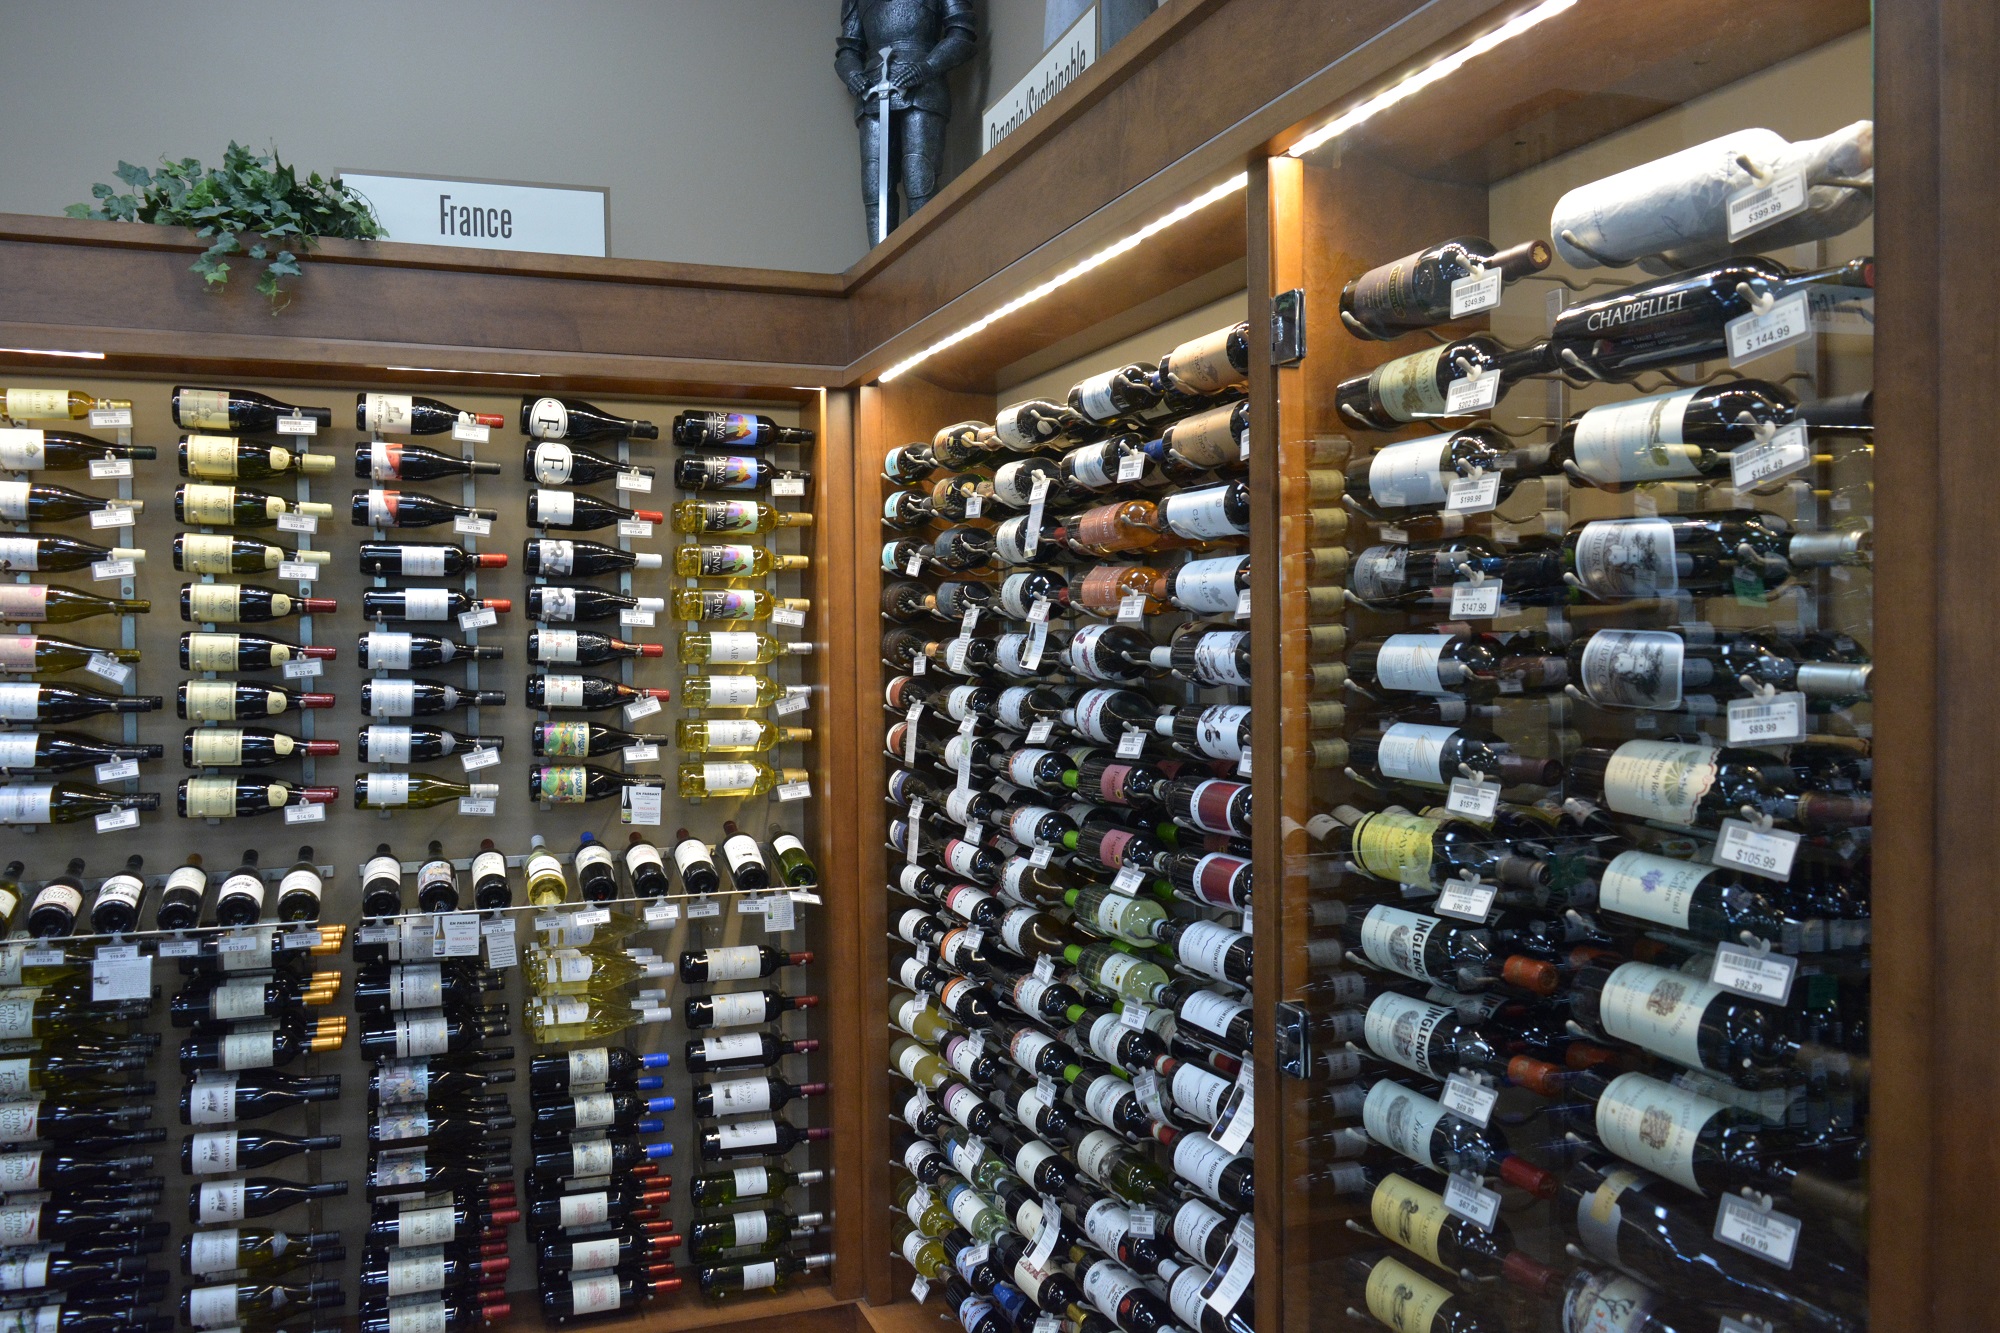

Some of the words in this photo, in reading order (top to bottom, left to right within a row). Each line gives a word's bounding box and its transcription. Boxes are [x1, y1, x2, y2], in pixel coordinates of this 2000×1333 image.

[440, 195, 512, 239] France
[1748, 202, 1782, 223] $399.99
[1464, 296, 1486, 308] $249.99
[1587, 290, 1688, 331] CHAPPELLET
[1756, 325, 1790, 346] 144.99
[1458, 398, 1479, 410] $202.99
[538, 416, 560, 432] F
[543, 456, 564, 471] F
[716, 456, 728, 484] PENYA
[1751, 459, 1783, 479] $146.49
[1460, 494, 1482, 504] $199.99
[716, 501, 727, 529] PENYA
[711, 545, 723, 574] PENYA
[713, 592, 725, 620] PENYA
[1461, 603, 1487, 612] $147.99
[1597, 639, 1611, 672] SILVER
[1749, 723, 1777, 734] $89.99
[1651, 748, 1679, 781] Chimney
[1650, 781, 1662, 806] Rock
[1460, 800, 1480, 811] $157.99
[956, 846, 964, 873] OKO
[1735, 849, 1776, 869] $105.99
[1664, 870, 1686, 902] Cellars
[1671, 867, 1702, 915] Cakebread
[957, 889, 977, 909] OKO
[1452, 903, 1472, 913] $96.99
[1212, 944, 1224, 973] MOUNTAIN
[1734, 978, 1763, 993] $92.99
[7, 1002, 21, 1031] FLYING
[1215, 1005, 1236, 1028] MOUNTAIN
[1206, 1082, 1220, 1103] BADGER
[953, 1092, 969, 1117] OKO
[1456, 1103, 1475, 1115] $69.99
[0, 1108, 12, 1130] SOLO
[12, 1108, 26, 1136] FLYING
[1, 1155, 14, 1175] SOLO
[13, 1154, 28, 1181] FLYING
[1207, 1162, 1218, 1190] MOUNTAIN
[957, 1195, 972, 1219] OKO
[1458, 1199, 1478, 1214] $67.99
[1, 1211, 14, 1233] SOLO
[14, 1209, 28, 1239] FLYING
[1201, 1215, 1217, 1235] BADGER
[1740, 1232, 1768, 1252] $69.99
[1193, 1297, 1202, 1327] MOUNTAIN
